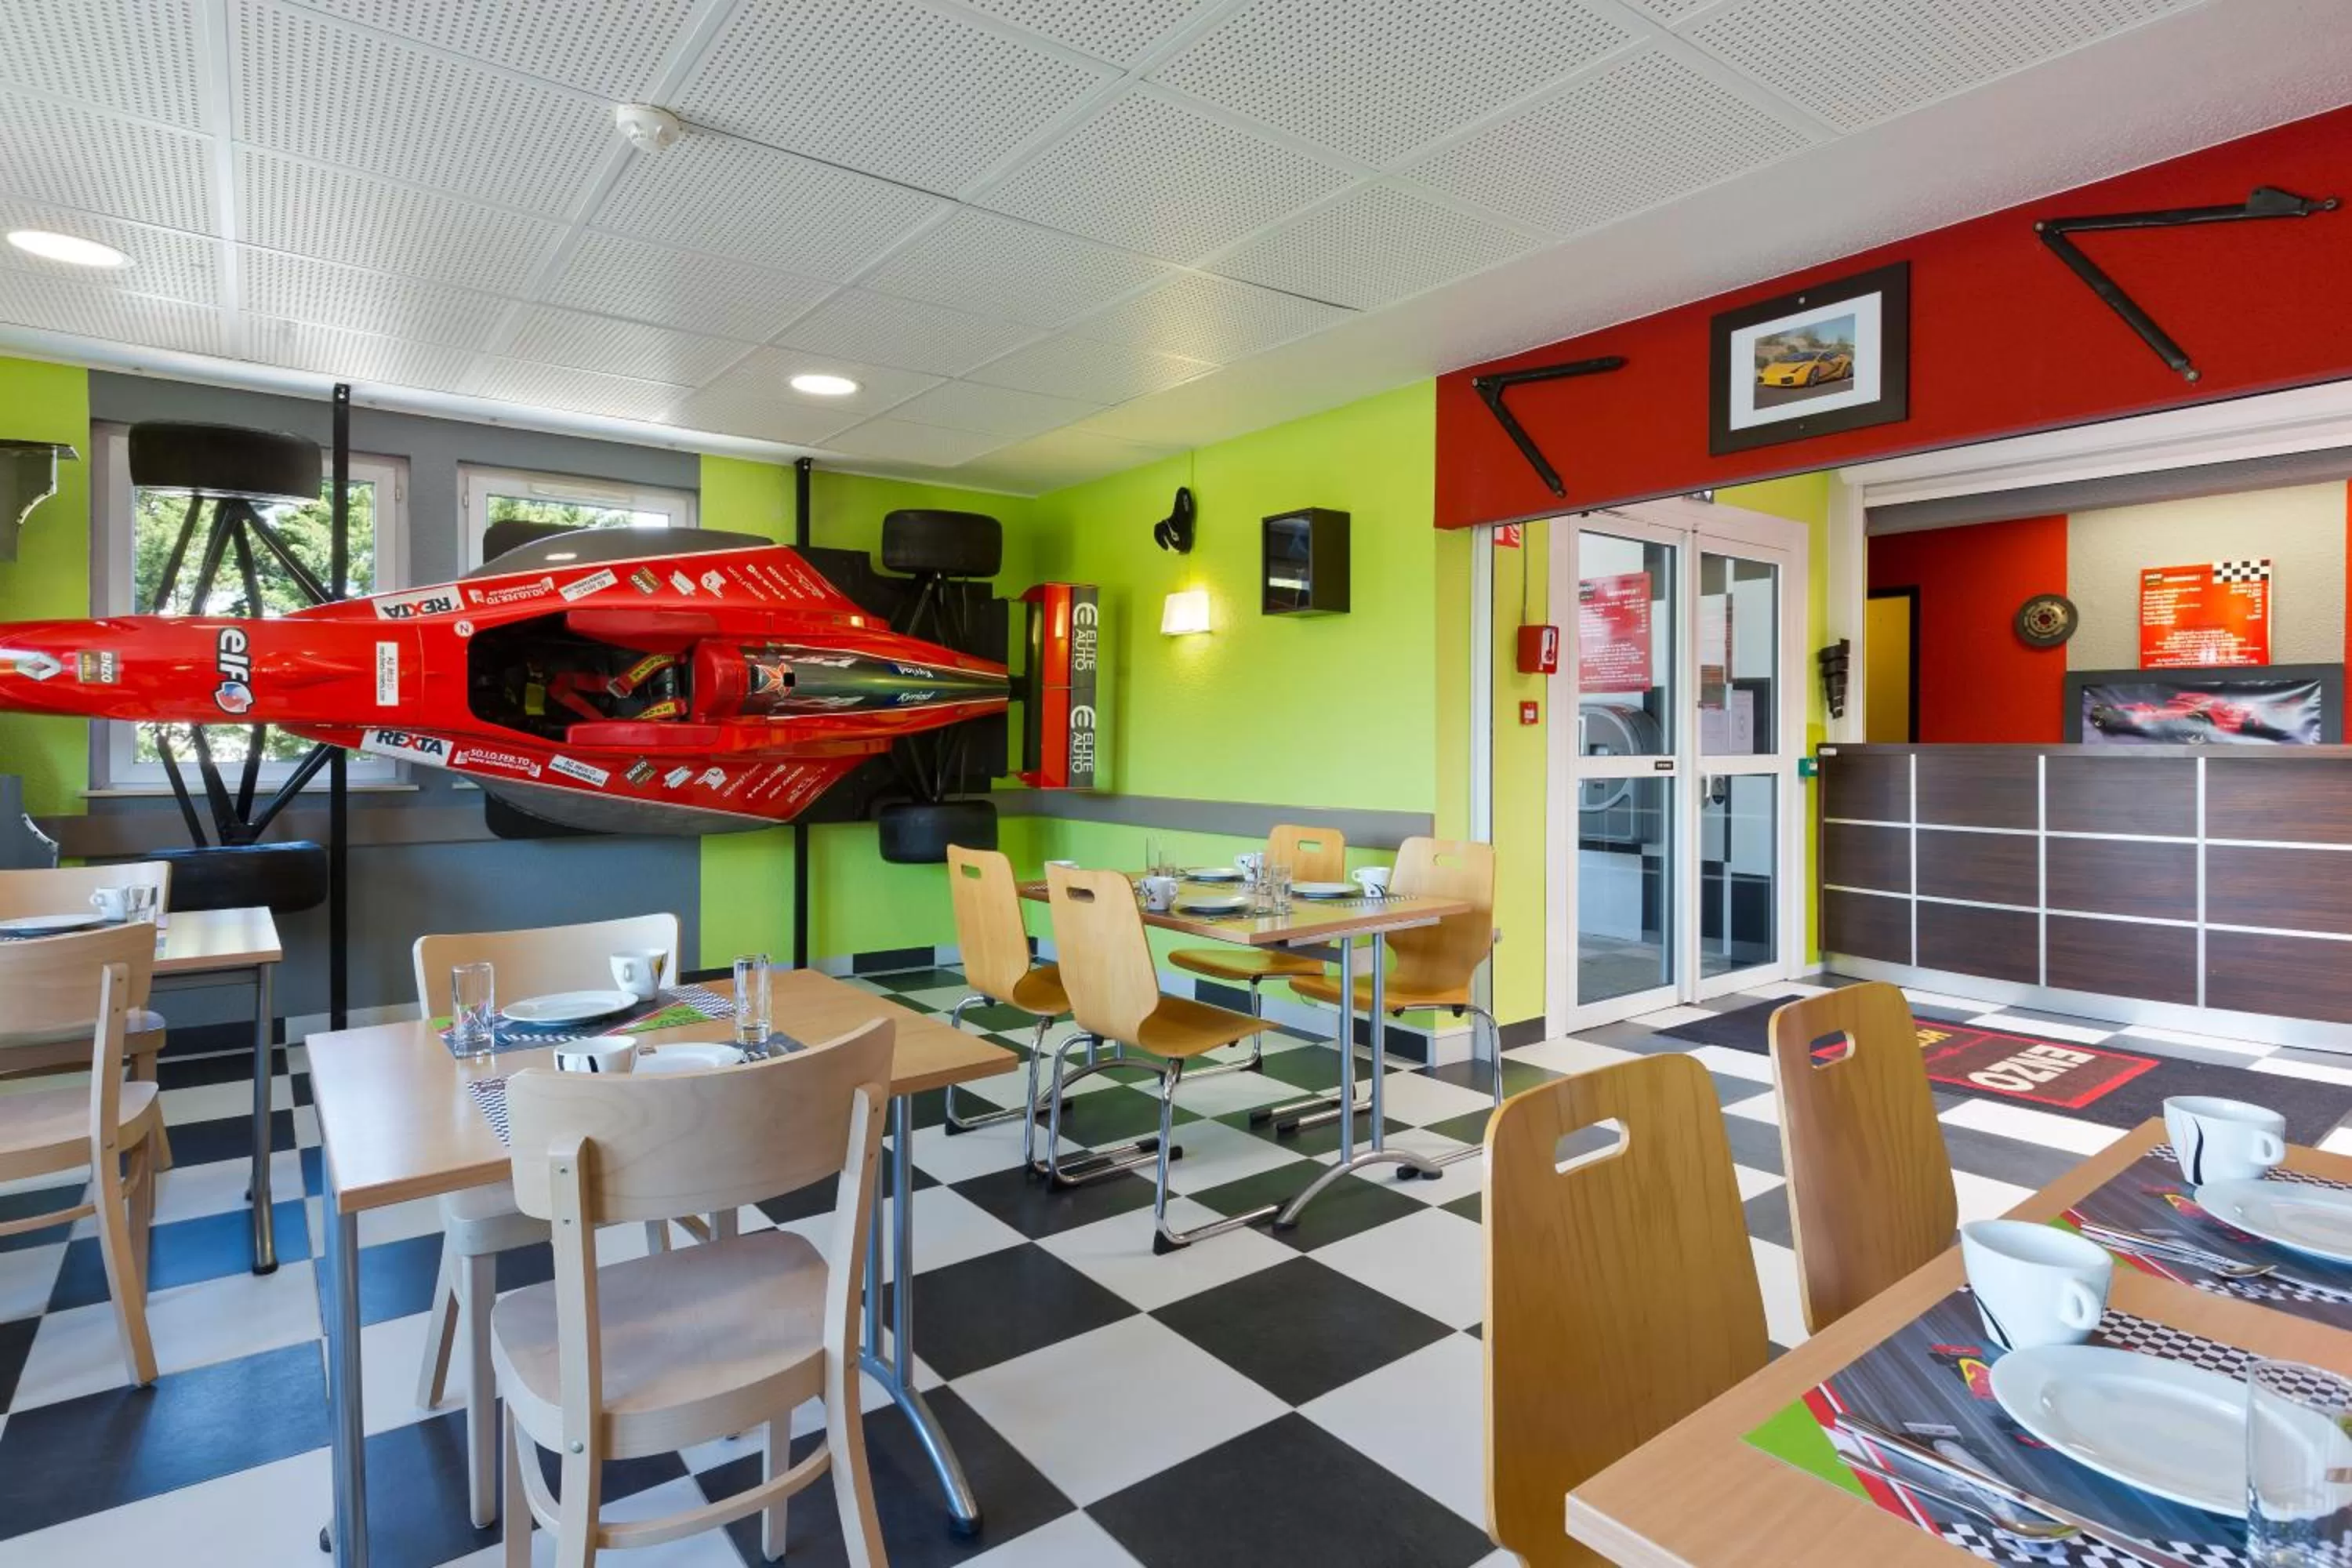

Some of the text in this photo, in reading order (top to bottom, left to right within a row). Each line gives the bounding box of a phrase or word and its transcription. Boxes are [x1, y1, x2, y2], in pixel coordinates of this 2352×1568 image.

[383, 597, 452, 619] REXTA
[100, 652, 113, 683] ENZO
[219, 628, 250, 683] elf
[1076, 630, 1087, 670] AUTO
[1086, 630, 1096, 670] ELITE
[376, 730, 444, 756] REXTA
[1072, 731, 1083, 773] AUTO
[1083, 732, 1093, 772] ELITE
[1968, 1044, 2096, 1092] ENZO
